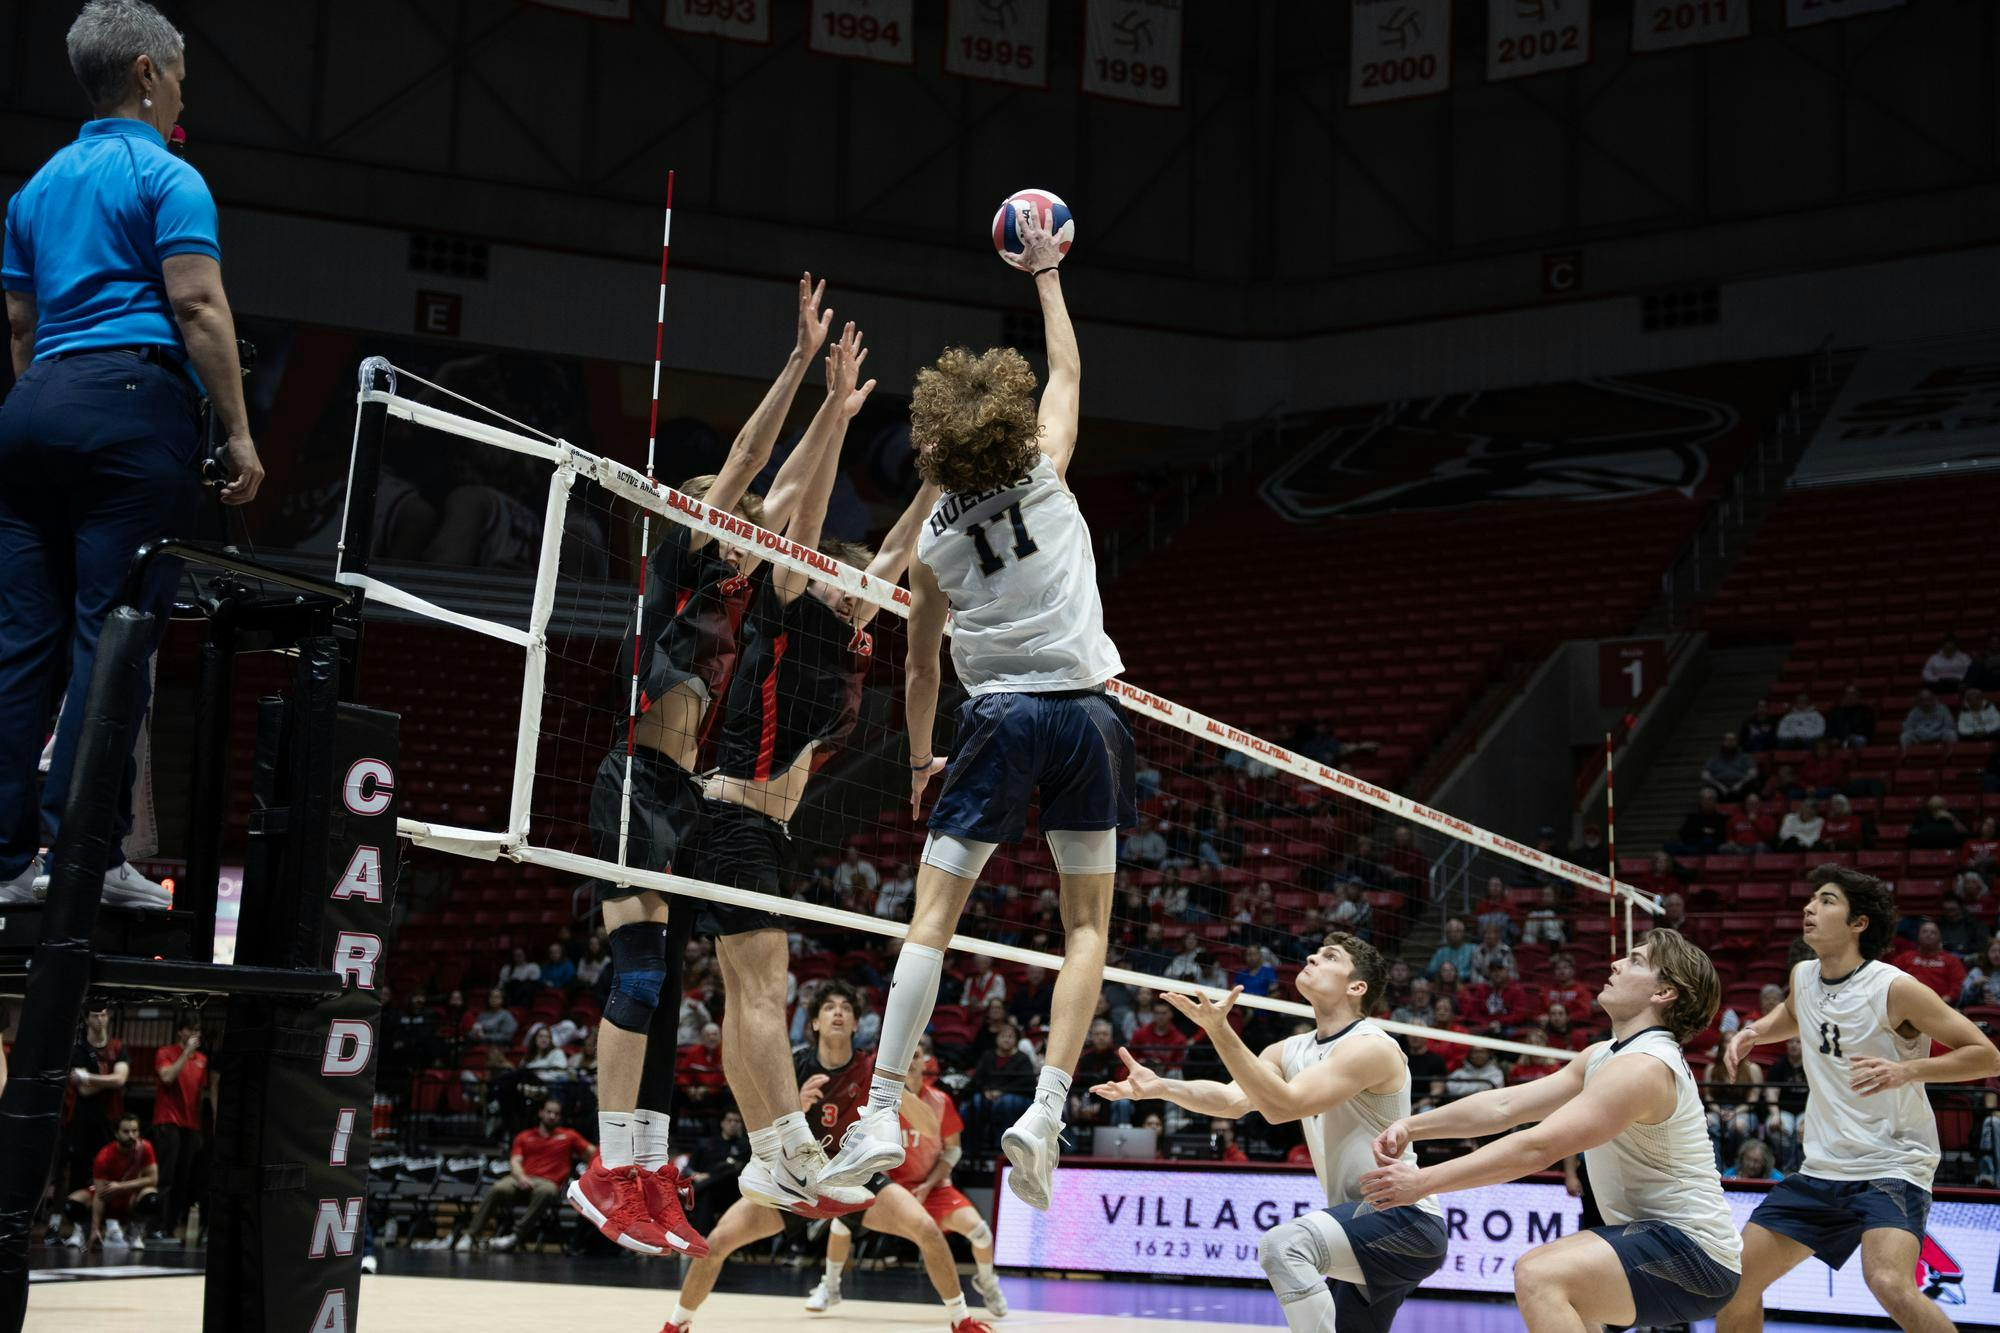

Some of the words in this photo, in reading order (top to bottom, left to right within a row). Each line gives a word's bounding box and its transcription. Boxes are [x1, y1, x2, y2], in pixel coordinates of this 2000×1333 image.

[823, 11, 900, 47] 1994
[1652, 0, 1729, 33] 2011
[960, 33, 1033, 70] 1995
[1497, 25, 1579, 64] 2002
[1095, 56, 1169, 90] 1999
[1361, 54, 1437, 88] 2000
[1551, 263, 1575, 290] C
[427, 303, 449, 331] E
[616, 470, 639, 488] ACTIVE
[667, 490, 704, 521] BALL
[708, 508, 754, 540] STATE
[756, 528, 839, 577] VOLLEYBALL
[966, 501, 1039, 577] 17
[891, 587, 912, 607] BA
[1621, 659, 1643, 698] 1
[1122, 684, 1173, 716] VOLLEYBALL
[1206, 721, 1225, 737] BALL
[1228, 728, 1250, 747] STATE
[1250, 739, 1292, 763] VOLLEYBALL
[1820, 1022, 1842, 1058] 11
[821, 1103, 838, 1128] 3
[1135, 1240, 1191, 1258] 1623
[1204, 1243, 1223, 1260] W
